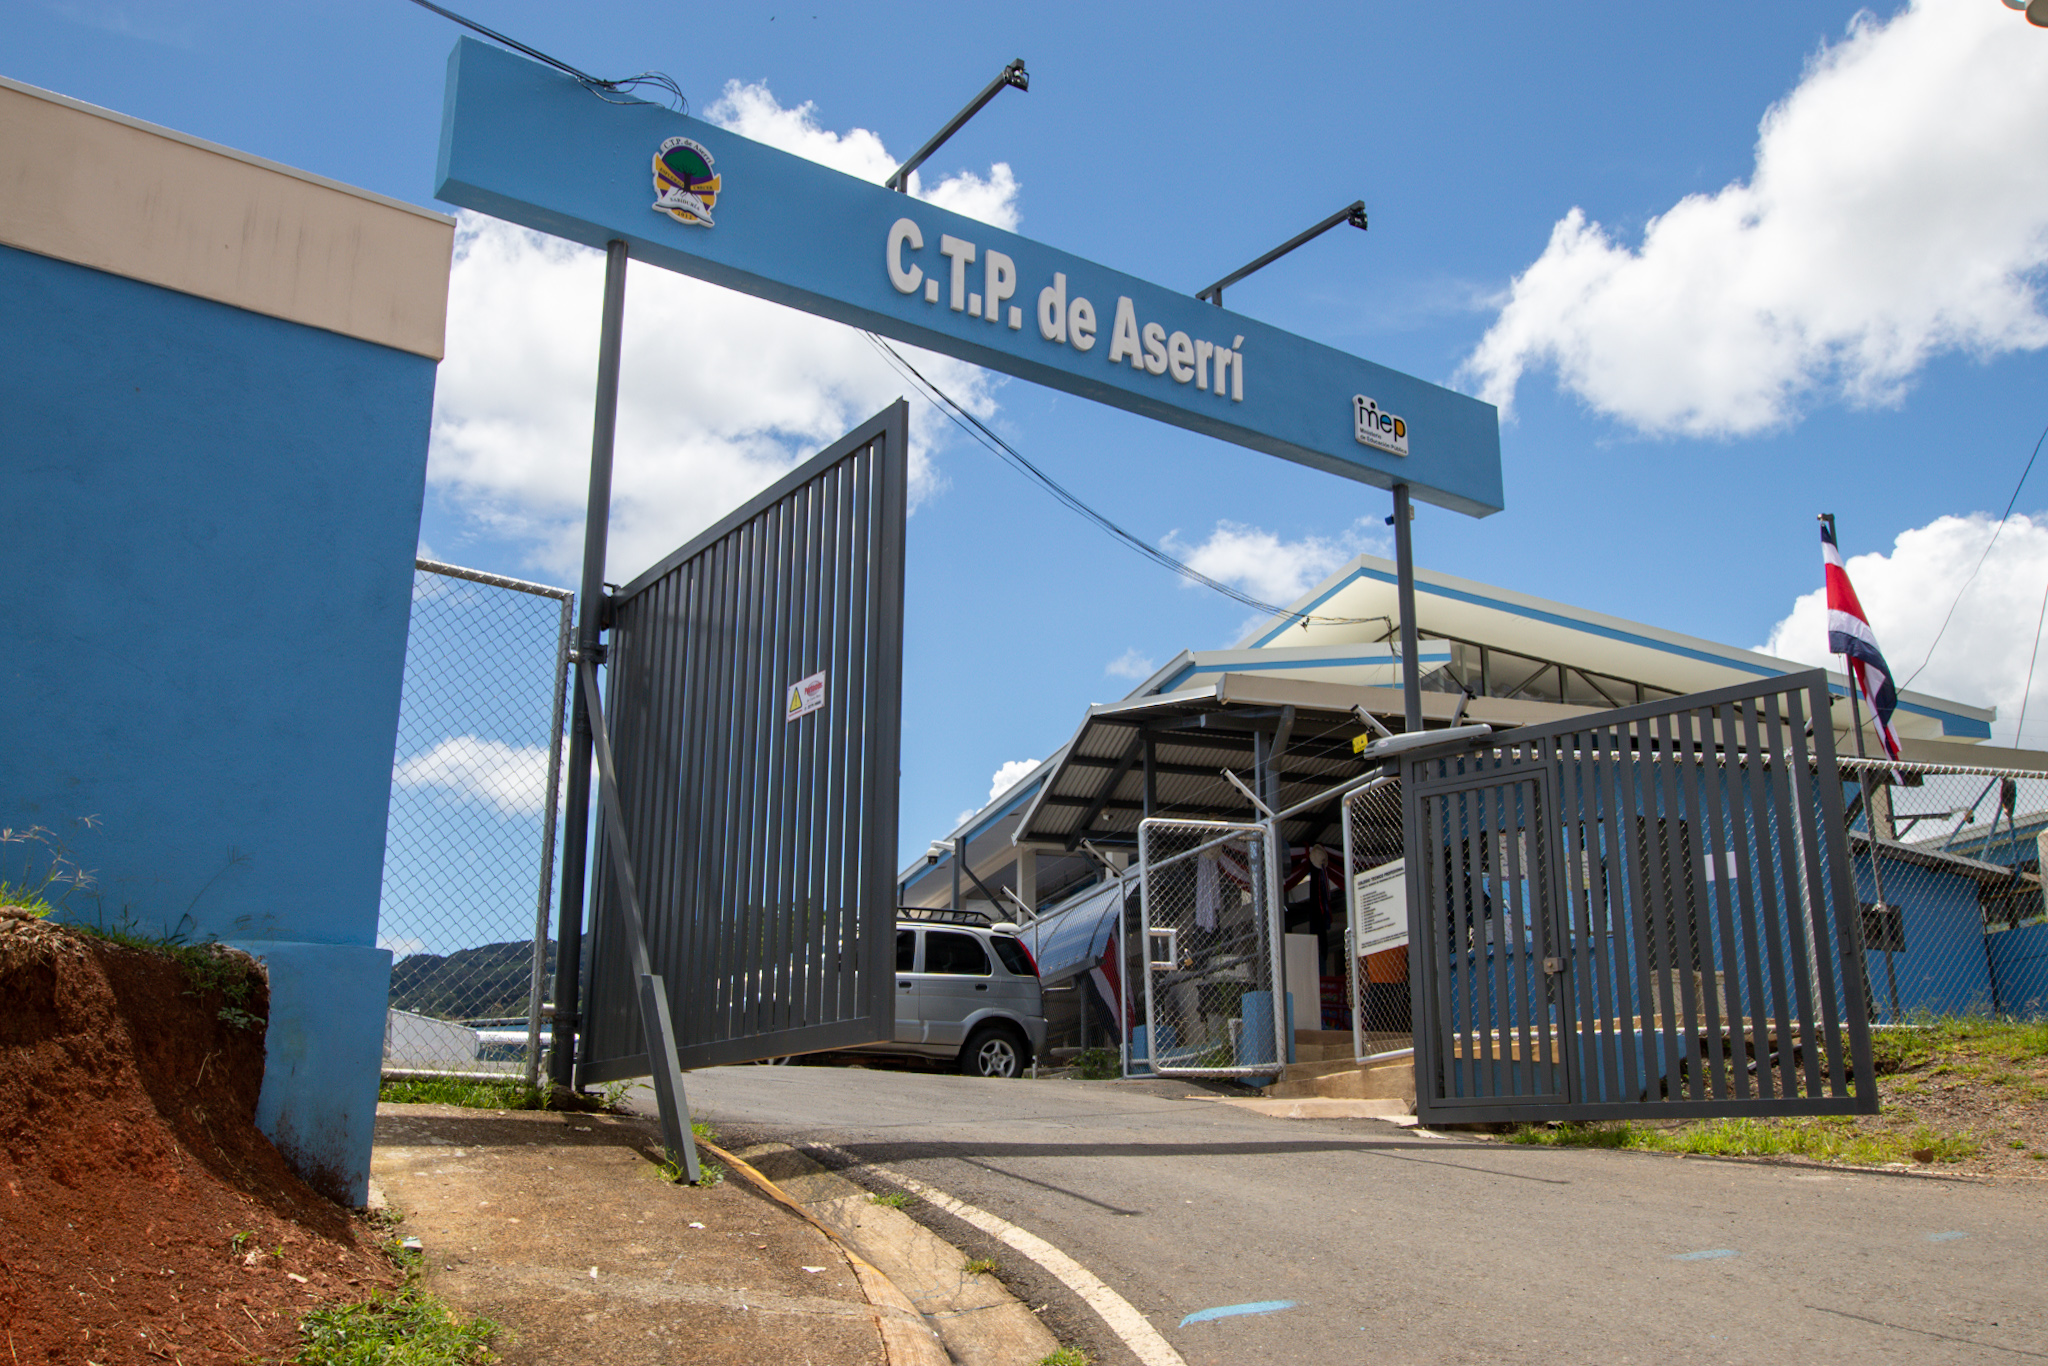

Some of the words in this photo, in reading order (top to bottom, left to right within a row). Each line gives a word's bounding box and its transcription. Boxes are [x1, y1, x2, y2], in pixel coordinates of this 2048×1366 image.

[684, 139, 693, 147] de
[677, 211, 693, 220] 2012
[886, 217, 1022, 331] C.T.P.
[1037, 271, 1097, 352] de
[1108, 295, 1245, 403] Aserrí
